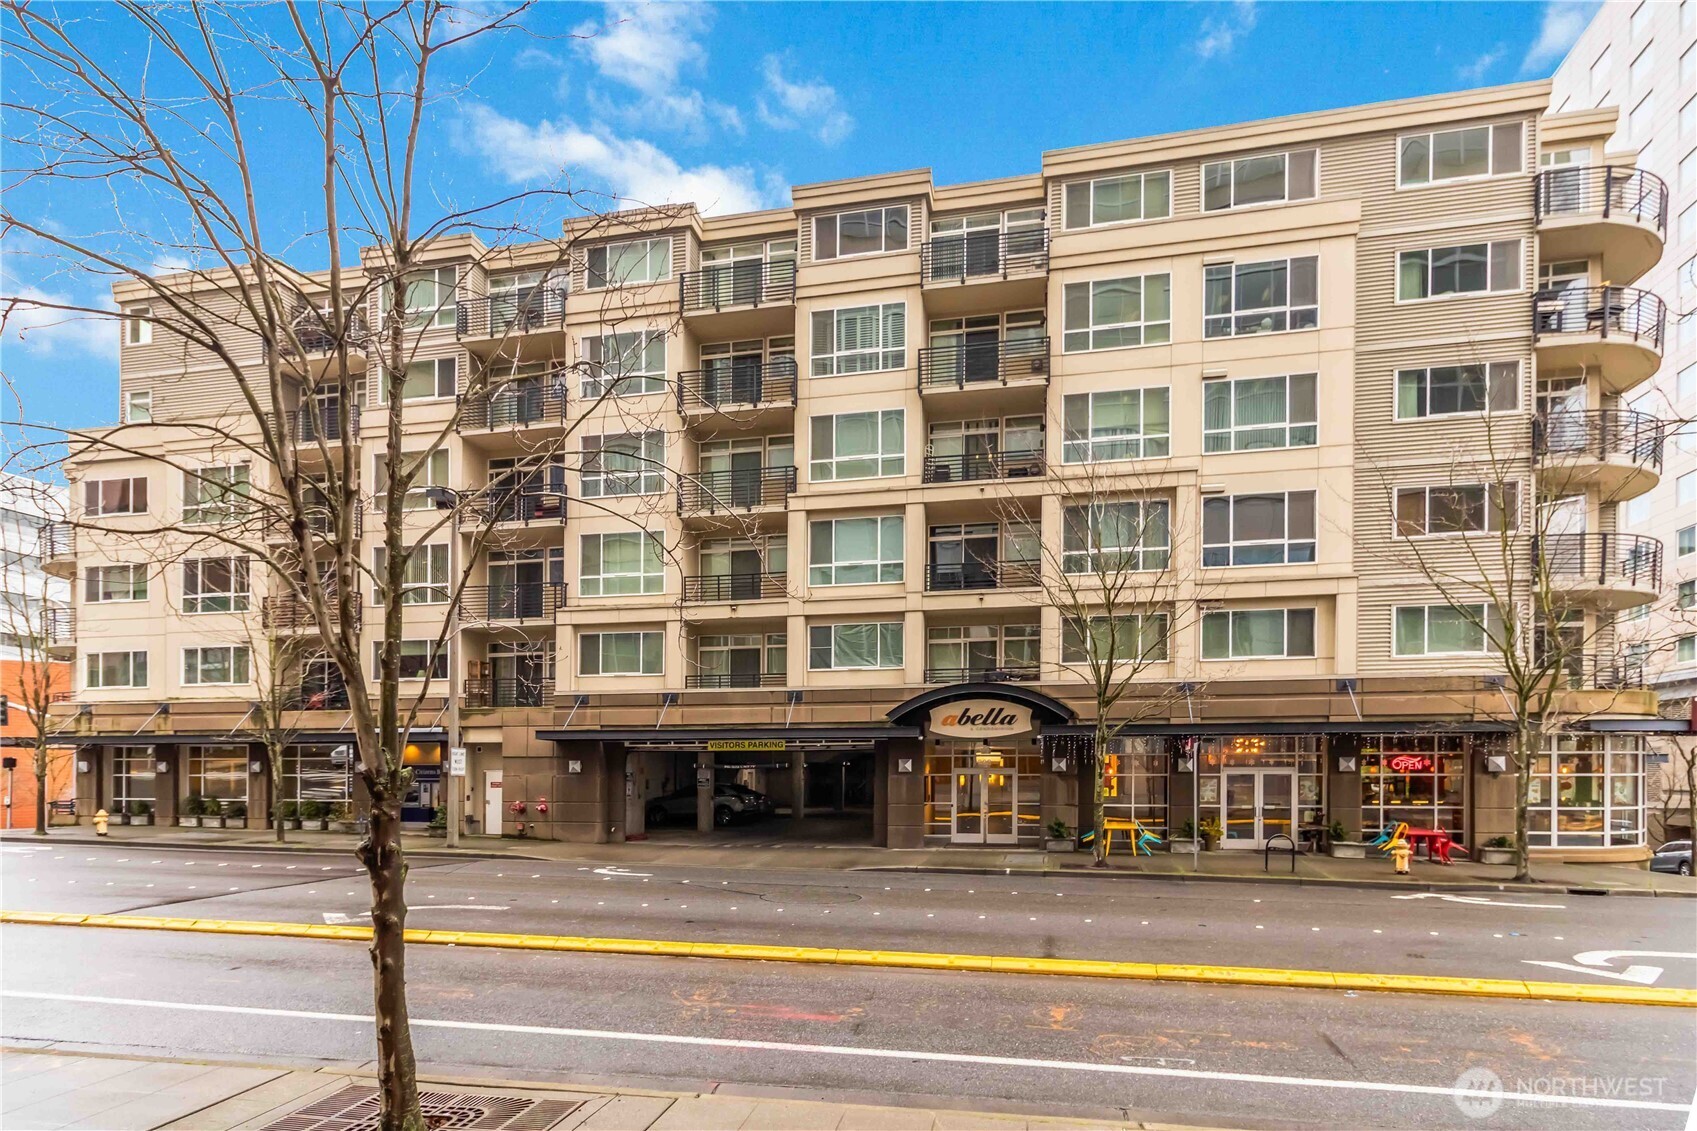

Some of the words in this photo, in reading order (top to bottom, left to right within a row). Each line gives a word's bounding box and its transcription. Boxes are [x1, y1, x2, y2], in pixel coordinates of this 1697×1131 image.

[941, 707, 1018, 726] abella
[709, 741, 746, 749] VISITORS
[747, 740, 784, 749] PARKING
[1391, 756, 1423, 770] OPEN
